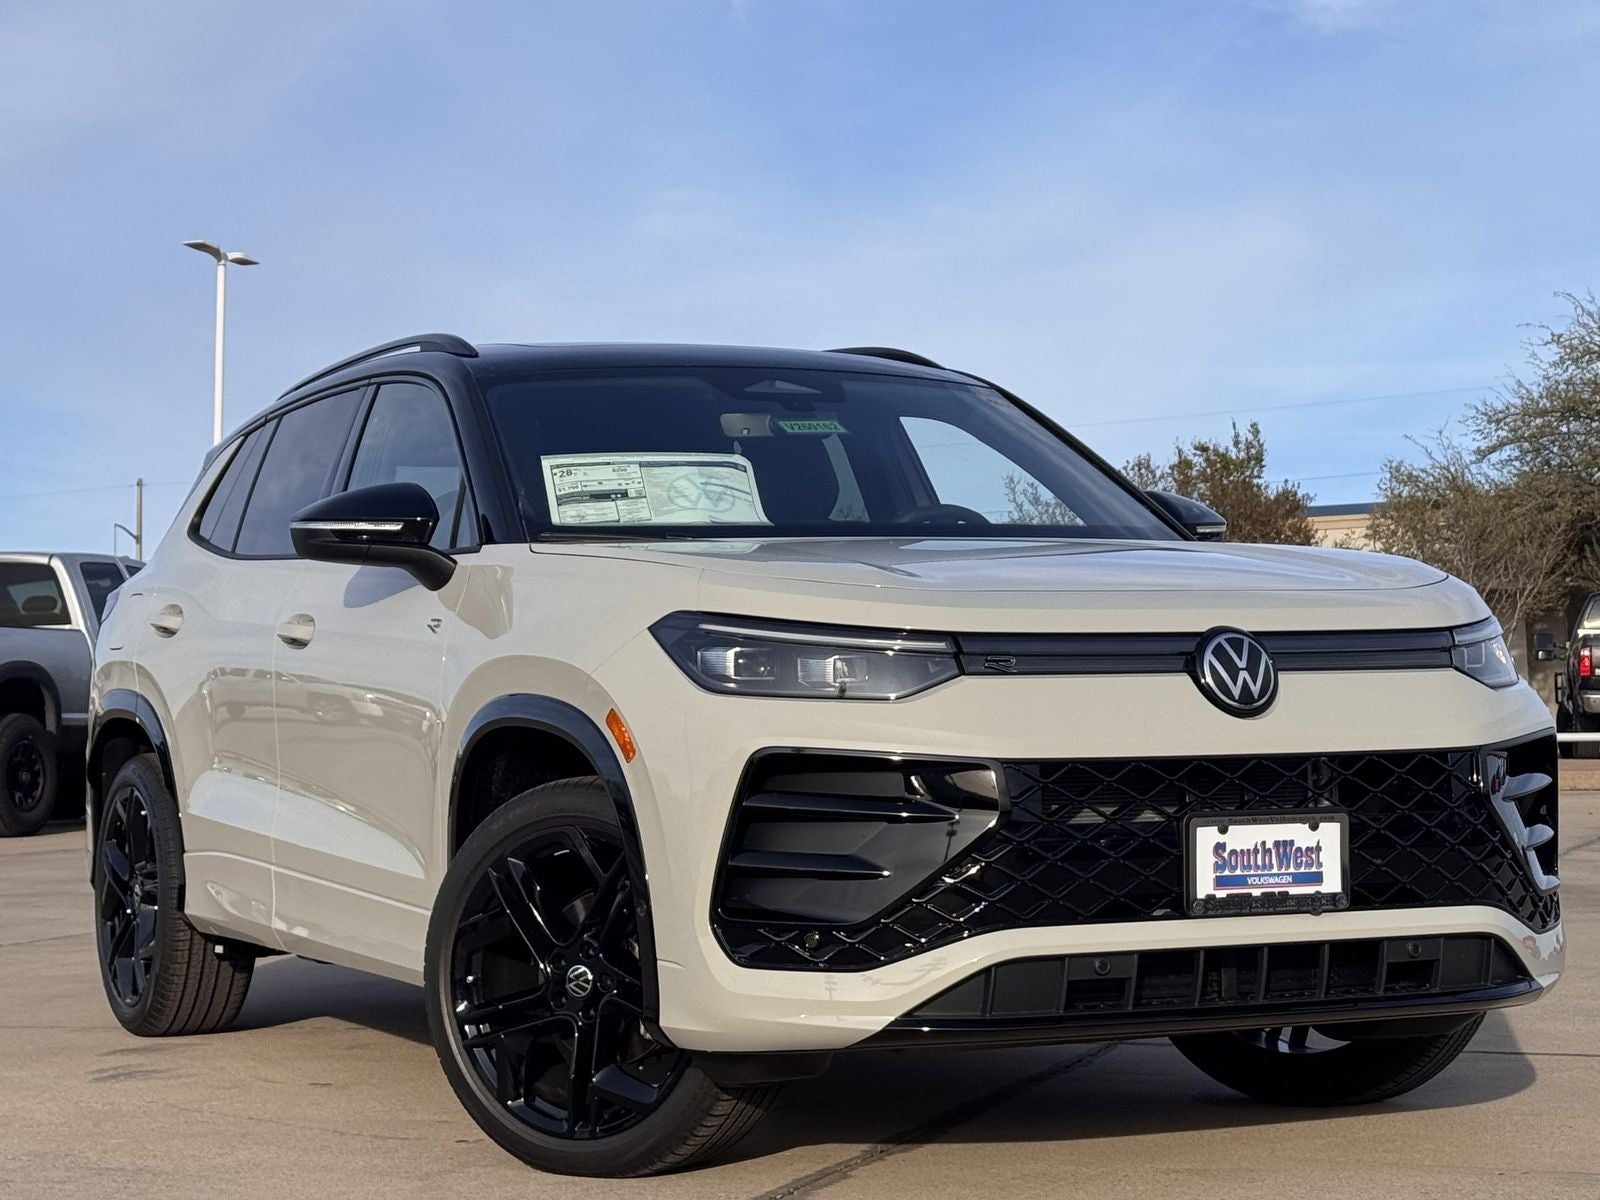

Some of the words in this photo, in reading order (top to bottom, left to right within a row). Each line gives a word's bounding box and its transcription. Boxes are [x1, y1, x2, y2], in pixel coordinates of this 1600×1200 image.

[559, 468, 573, 478] 28
[1213, 838, 1323, 874] SouthWest
[1247, 875, 1292, 885] VOLKSWAGEN
